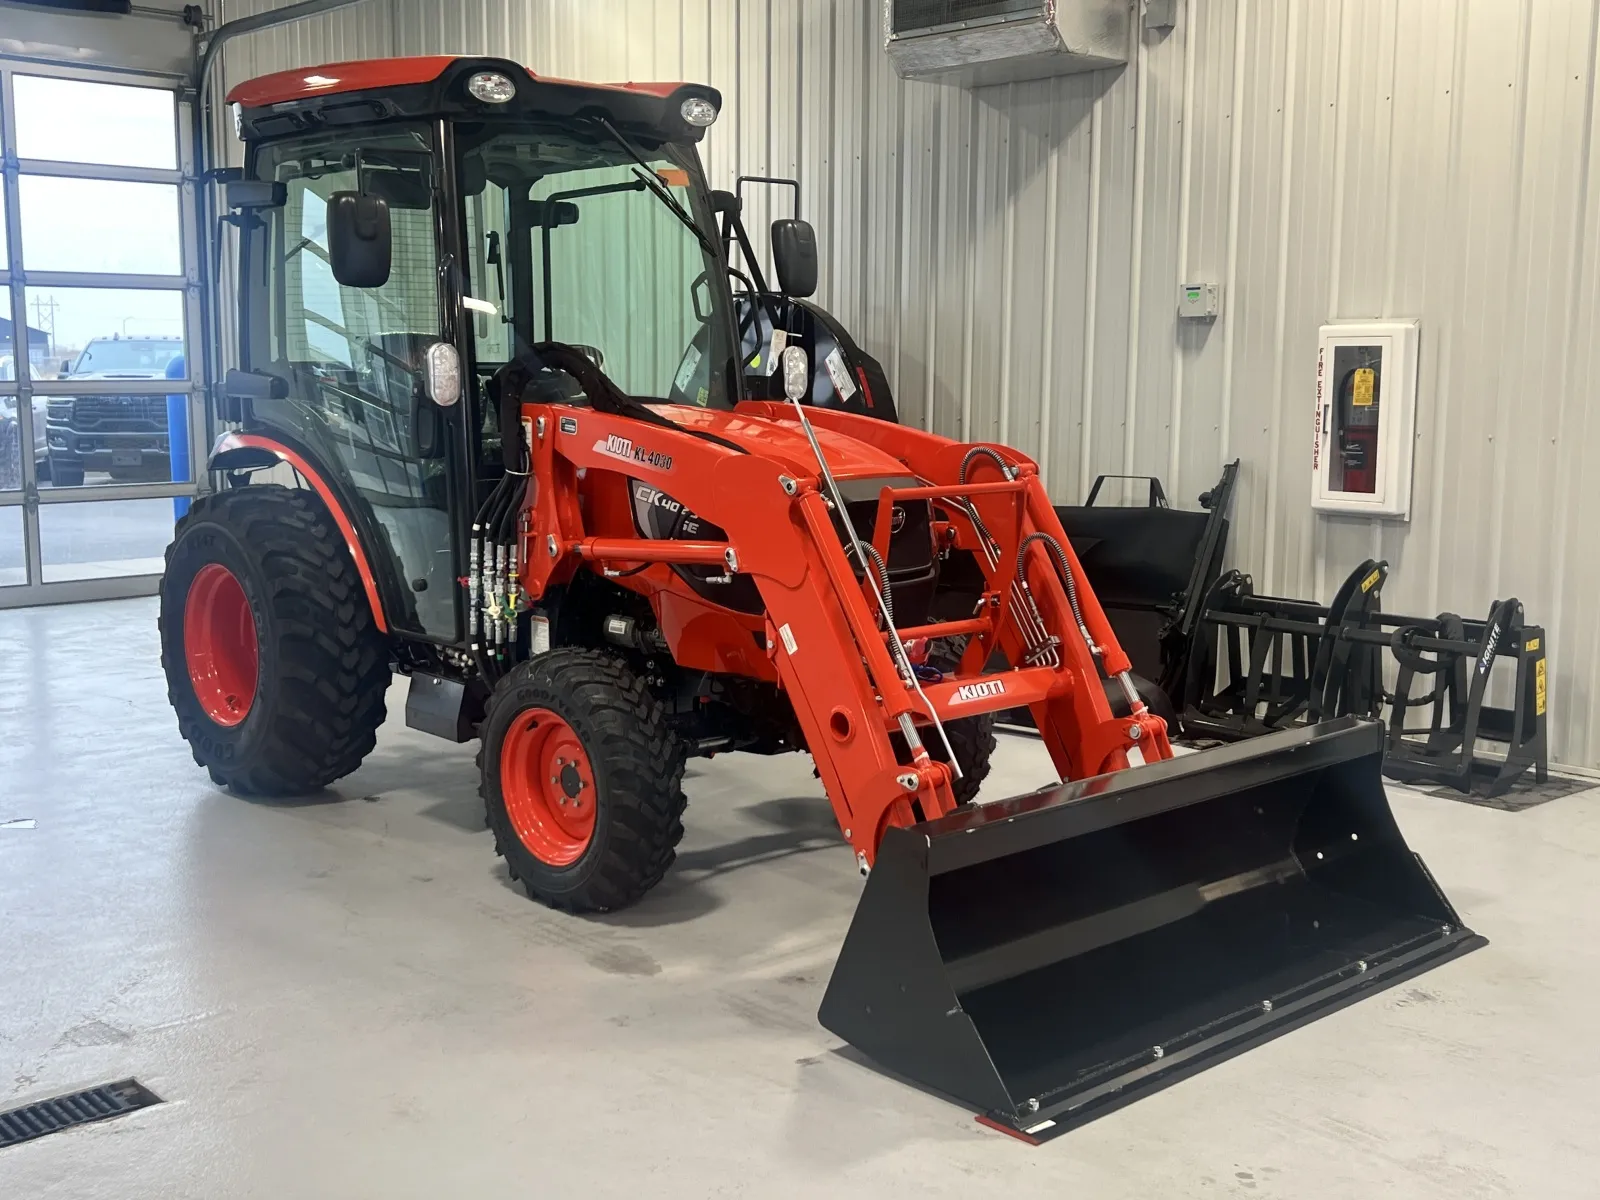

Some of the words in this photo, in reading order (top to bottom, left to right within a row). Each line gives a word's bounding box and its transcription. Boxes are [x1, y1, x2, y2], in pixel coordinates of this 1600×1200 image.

[1313, 380, 1322, 470] EXTINGUISHER
[606, 434, 633, 458] KIOTI
[635, 486, 698, 519] CK402
[1482, 622, 1500, 665] IGNITE
[958, 679, 1006, 701] KIOTI
